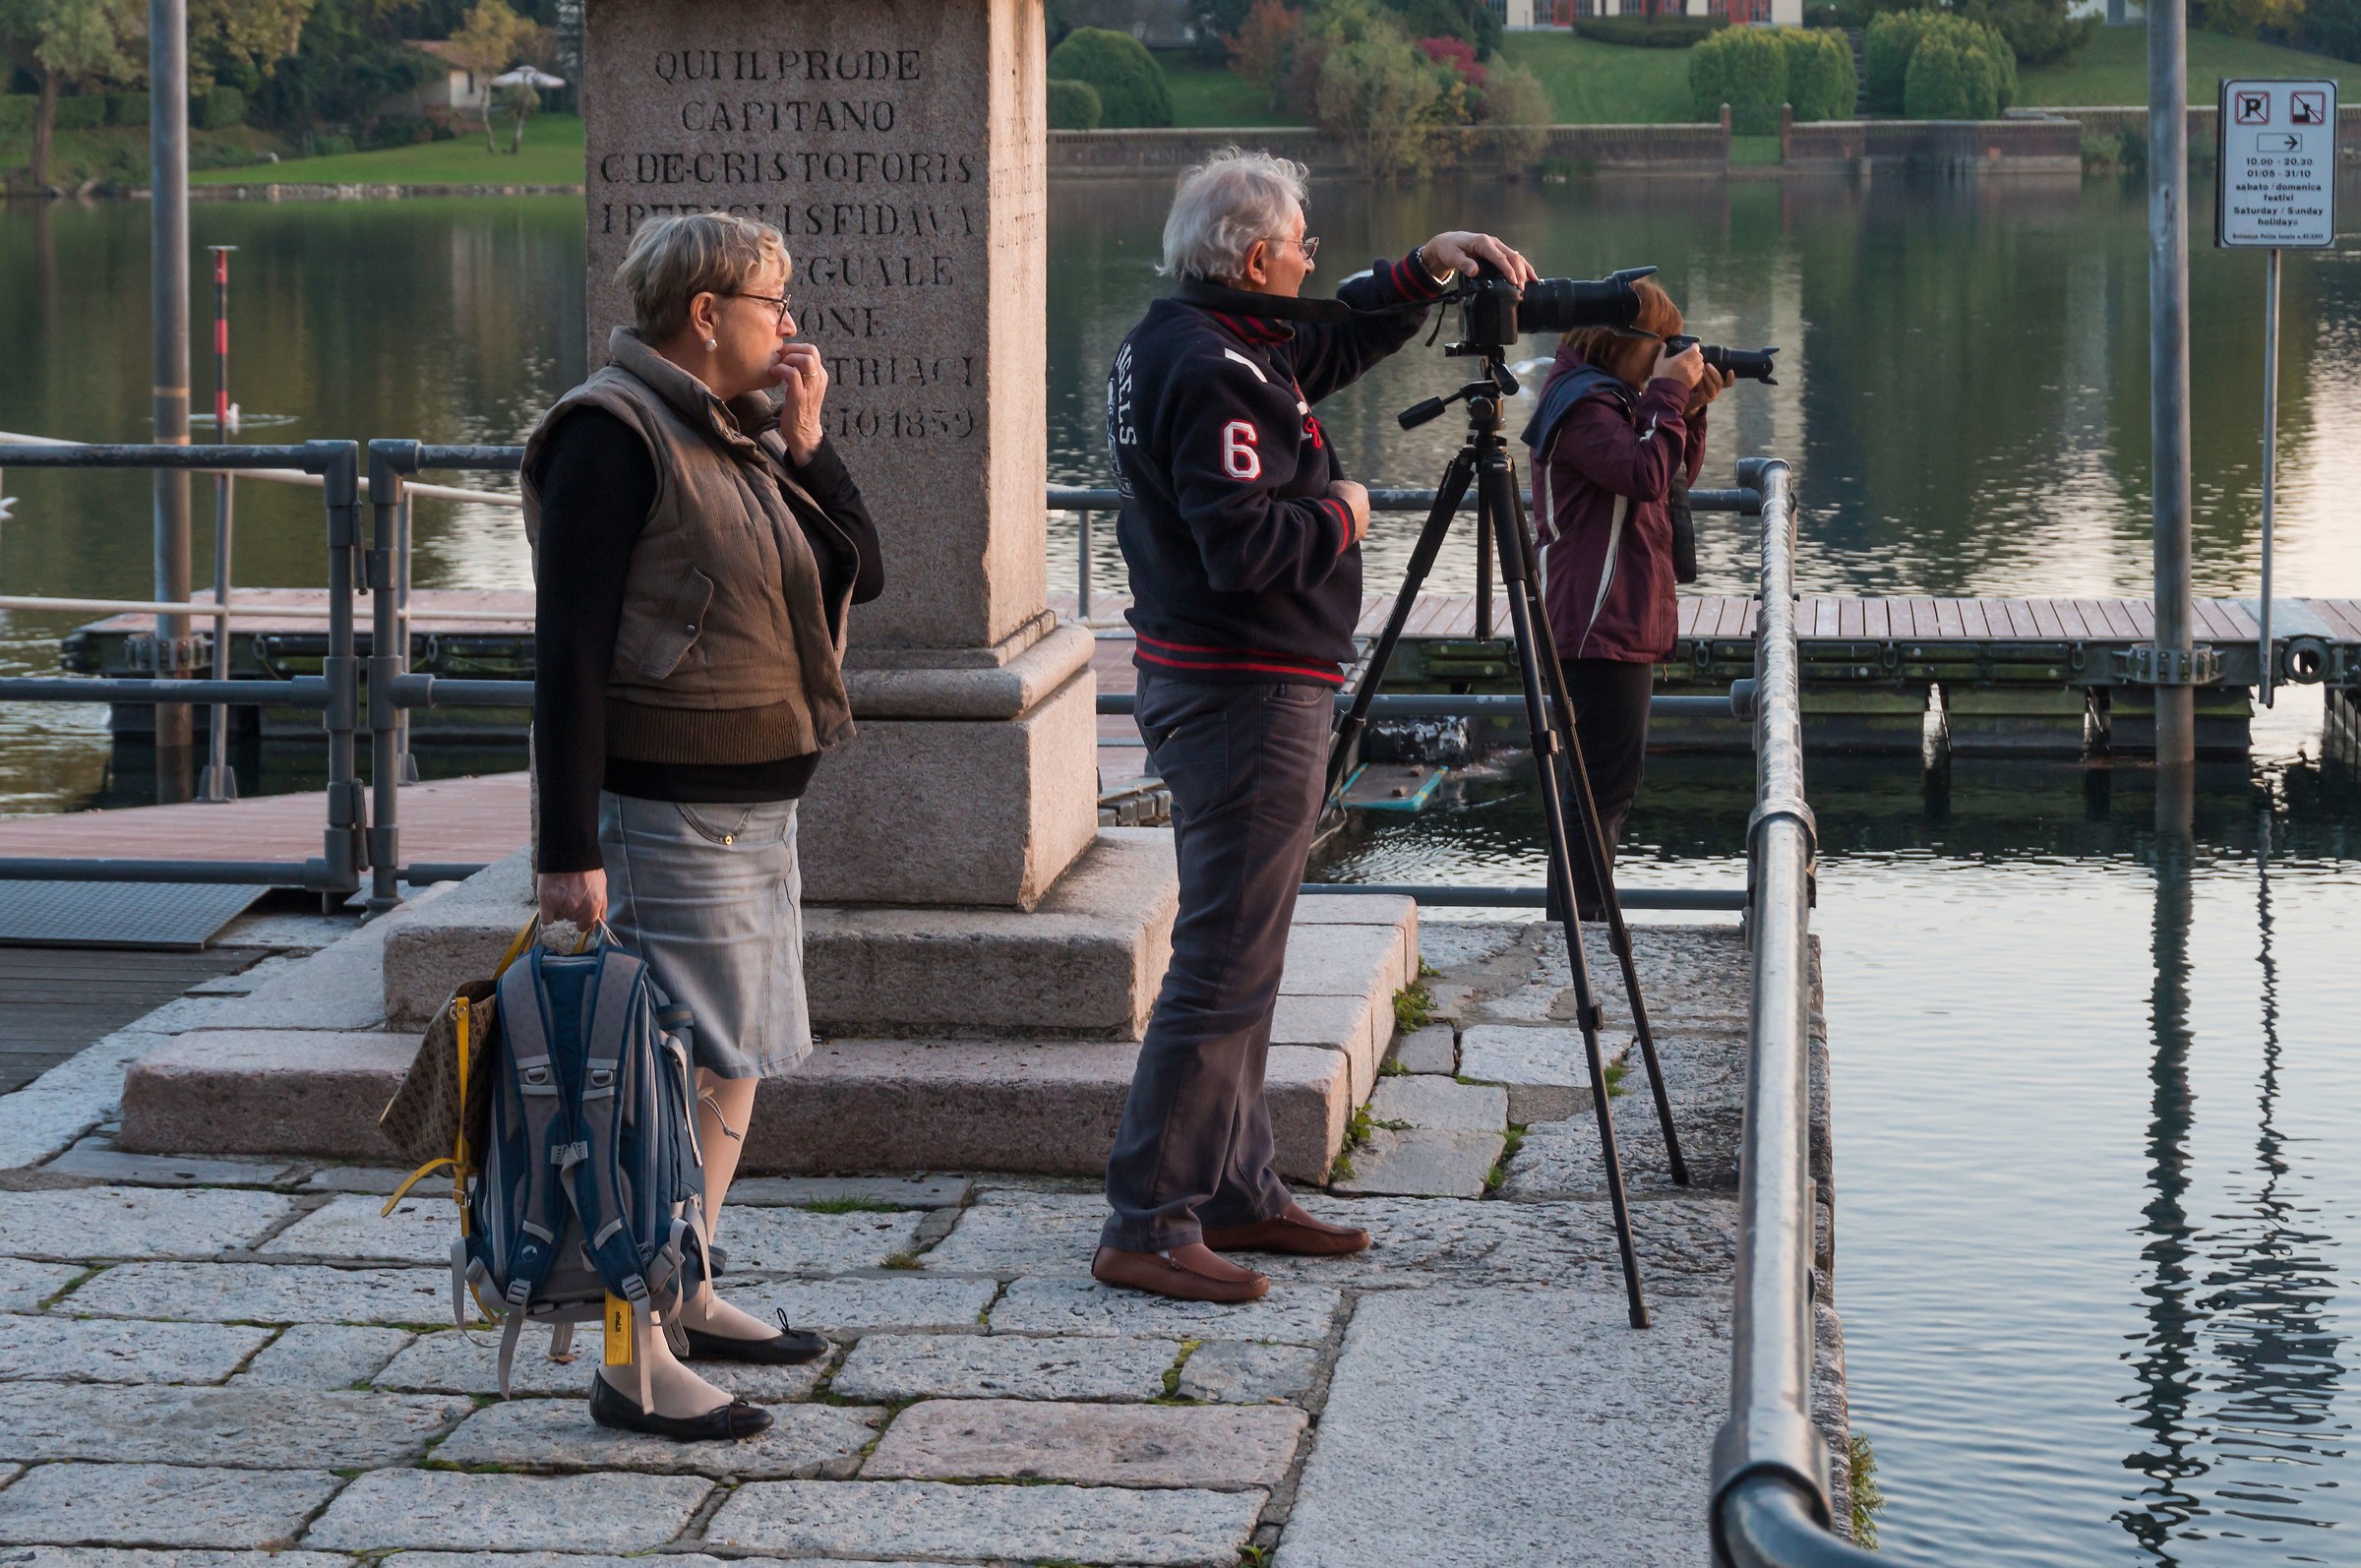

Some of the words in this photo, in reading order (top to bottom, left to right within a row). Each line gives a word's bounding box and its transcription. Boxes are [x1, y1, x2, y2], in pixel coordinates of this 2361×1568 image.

[654, 50, 720, 85] QUI
[733, 50, 771, 81] IL
[681, 100, 896, 132] CAPITANO
[2236, 182, 2269, 191] sabato
[2275, 182, 2322, 191] domenica
[2233, 206, 2278, 215] Saturday
[2286, 206, 2324, 216] Sunday
[1222, 418, 1262, 481] 6
